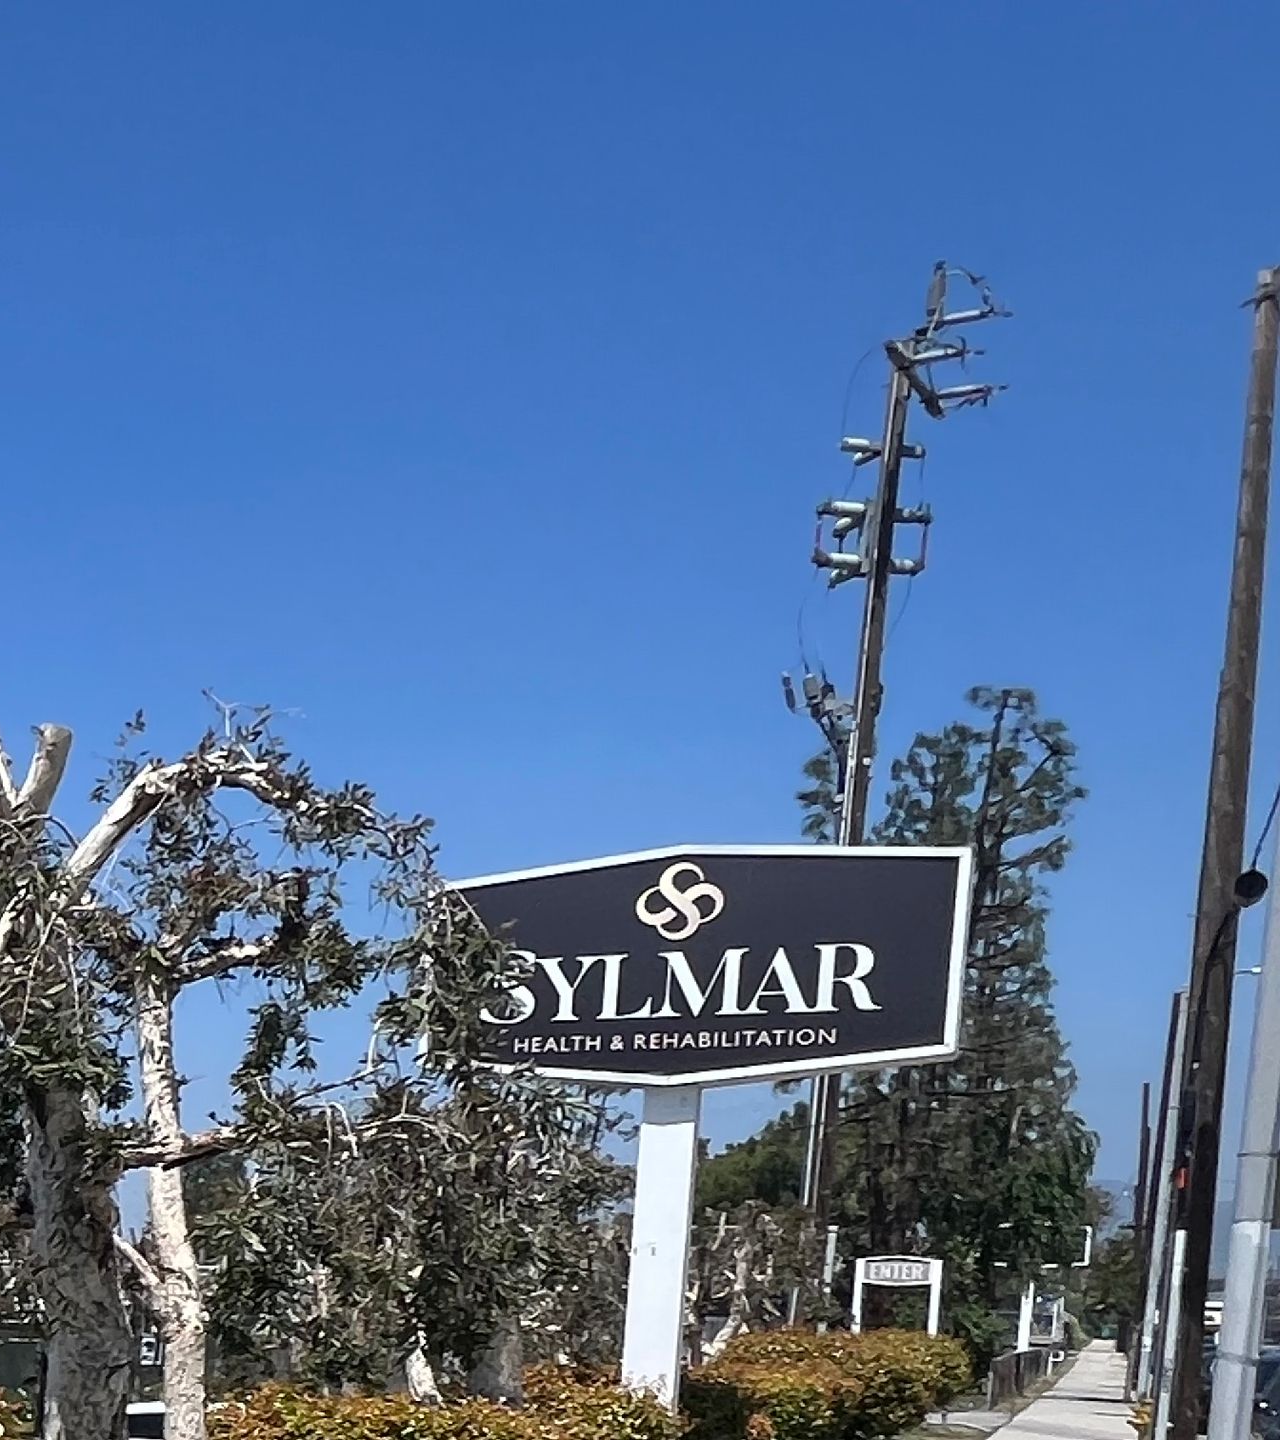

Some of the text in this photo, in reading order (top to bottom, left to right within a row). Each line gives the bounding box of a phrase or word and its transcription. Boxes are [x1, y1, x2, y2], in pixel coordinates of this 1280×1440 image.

[478, 942, 883, 1025] SYLMAR
[513, 1028, 838, 1054] HEALTH & REHABILITATION
